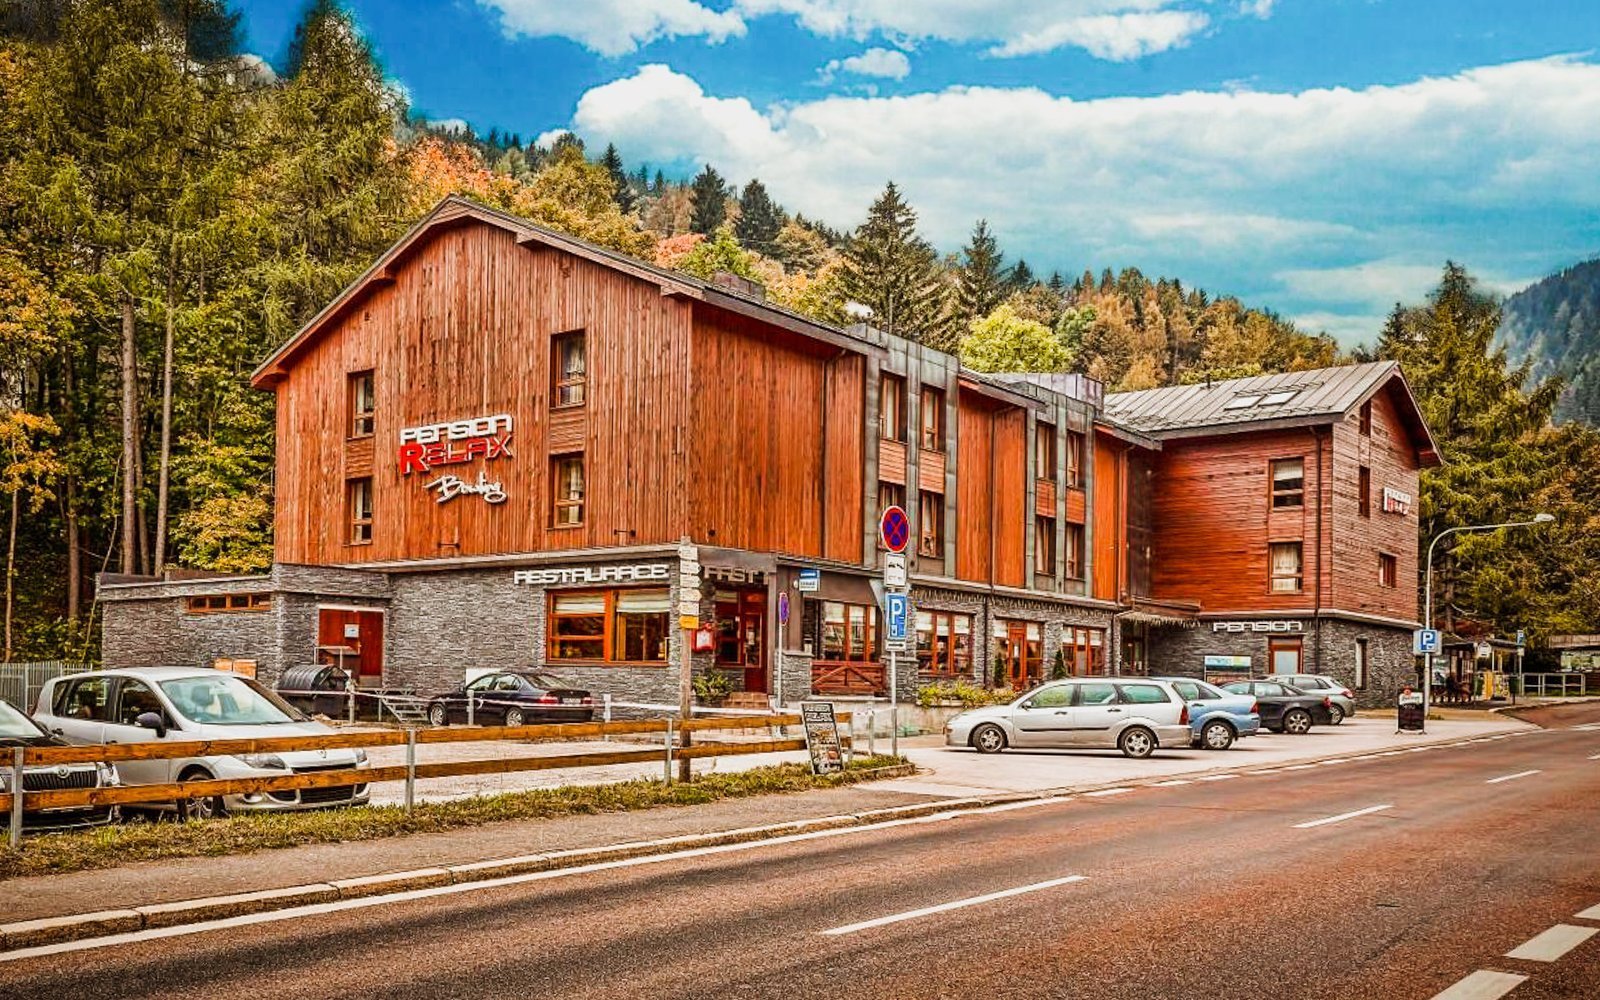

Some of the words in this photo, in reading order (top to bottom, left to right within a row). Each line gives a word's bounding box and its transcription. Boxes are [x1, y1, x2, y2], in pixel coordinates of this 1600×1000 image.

[397, 434, 513, 474] RELAX
[891, 598, 903, 625] P
[1213, 621, 1303, 632] PENSION
[1422, 631, 1435, 646] P
